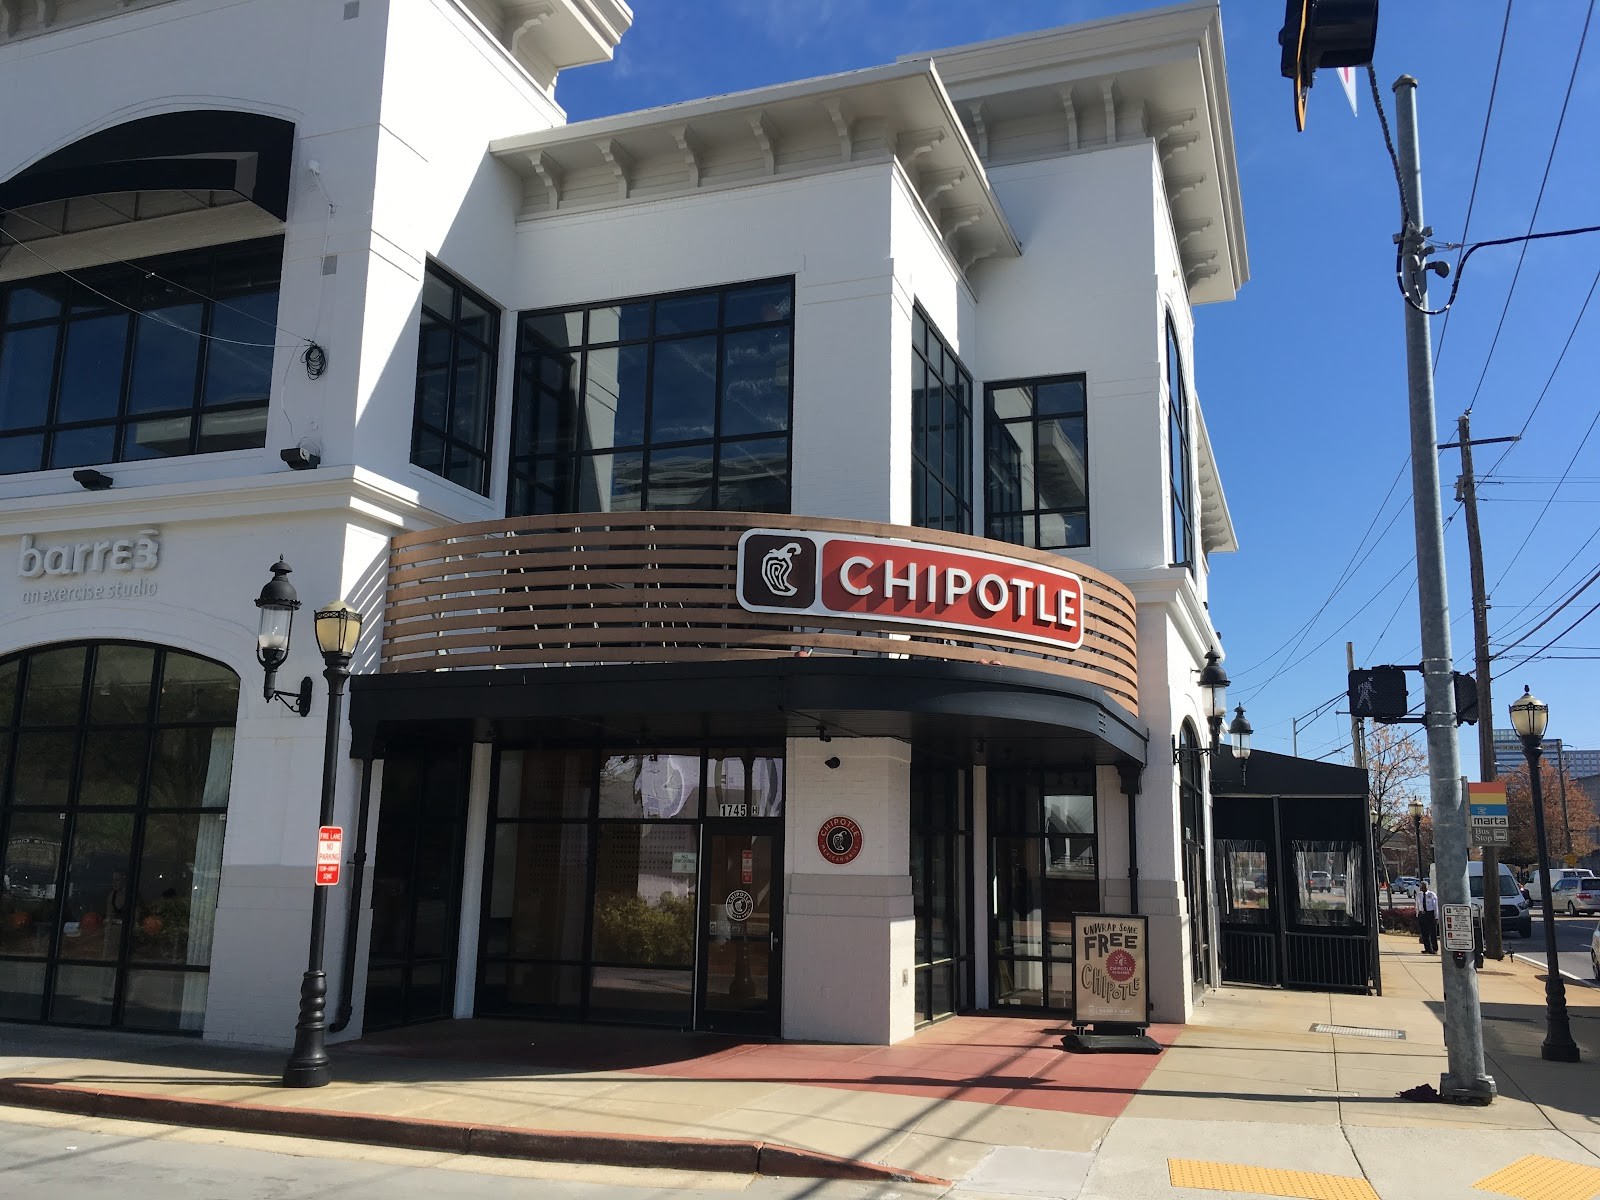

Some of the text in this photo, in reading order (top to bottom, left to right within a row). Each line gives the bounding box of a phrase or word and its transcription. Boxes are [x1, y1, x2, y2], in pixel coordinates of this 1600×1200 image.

[22, 577, 158, 604] an exercise studio
[838, 555, 1078, 628] CHIPOTLE
[721, 803, 747, 817] 1745
[820, 818, 860, 837] CHIPOTLE
[1473, 816, 1507, 826] marta
[320, 832, 329, 840] FIRE
[1475, 827, 1490, 835] Bus
[1475, 834, 1493, 843] Stop
[319, 853, 340, 861] PARKING
[1083, 922, 1138, 936] UNWRAP SOME
[1084, 932, 1138, 961] FREE
